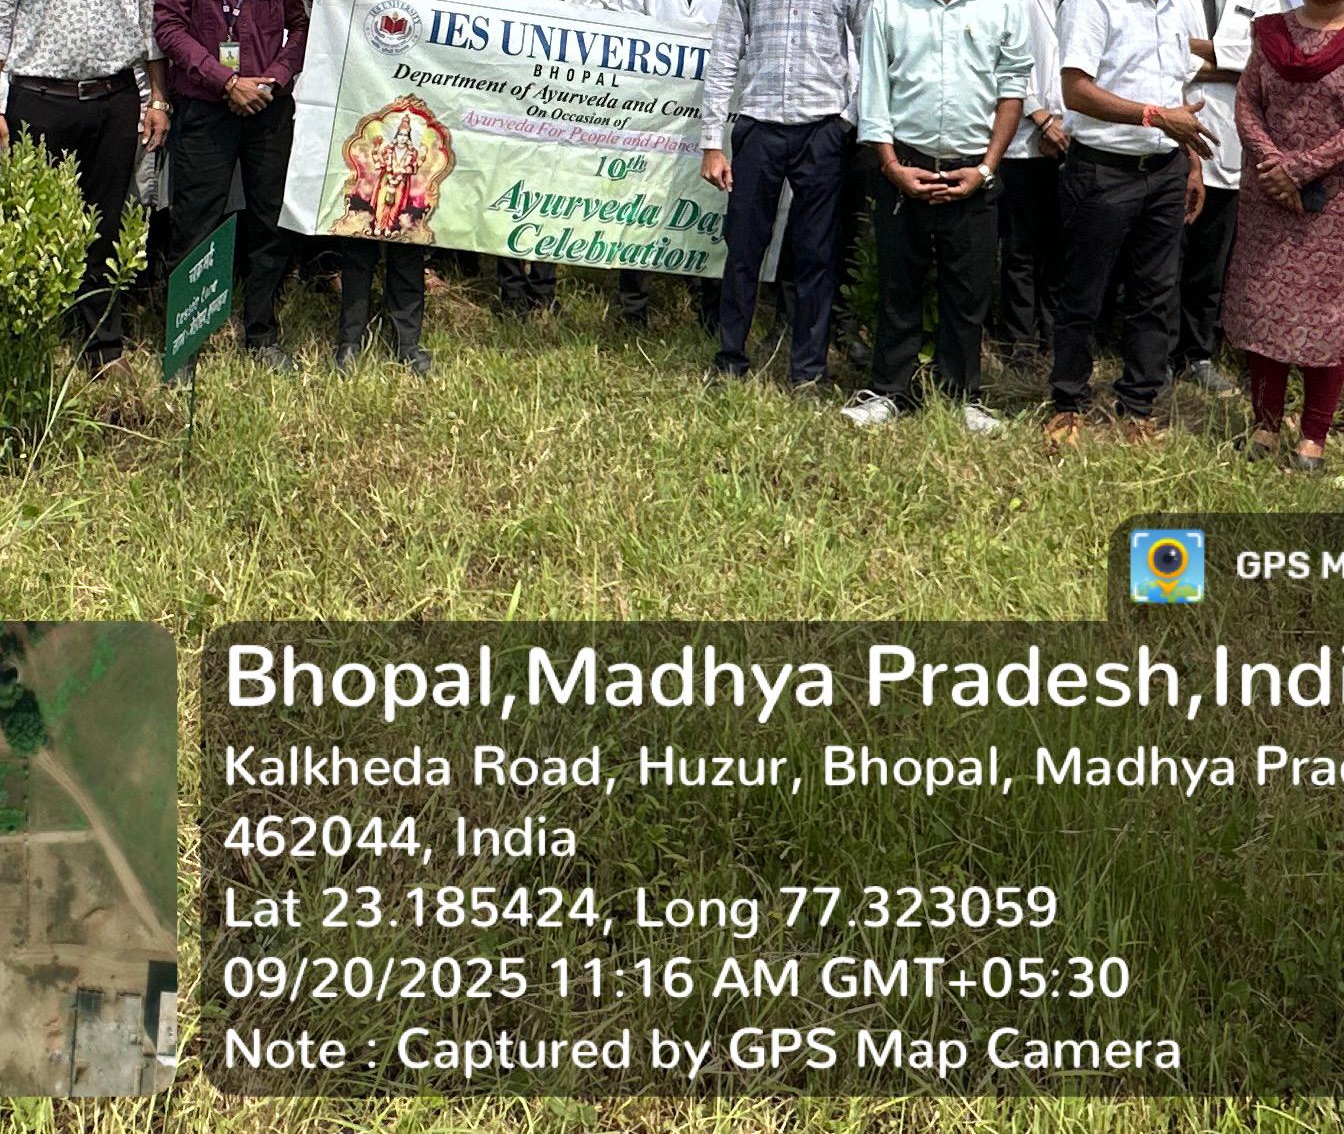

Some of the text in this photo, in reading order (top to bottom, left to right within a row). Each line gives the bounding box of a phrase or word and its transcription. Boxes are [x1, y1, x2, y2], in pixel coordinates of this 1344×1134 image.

[425, 9, 712, 81] IES UNIVERSIT
[392, 63, 508, 94] Department
[510, 82, 536, 101] of
[532, 84, 619, 110] Ayurveda
[622, 98, 658, 114] and
[533, 64, 620, 87] BHOPAL
[462, 110, 533, 133] Ayurveda
[536, 122, 567, 138] For
[568, 126, 620, 146] People
[622, 134, 653, 148] and
[526, 105, 632, 130] On Occasion of
[594, 154, 648, 180] 10th
[488, 179, 662, 228] Ayurveda
[506, 222, 710, 272] Celebration
